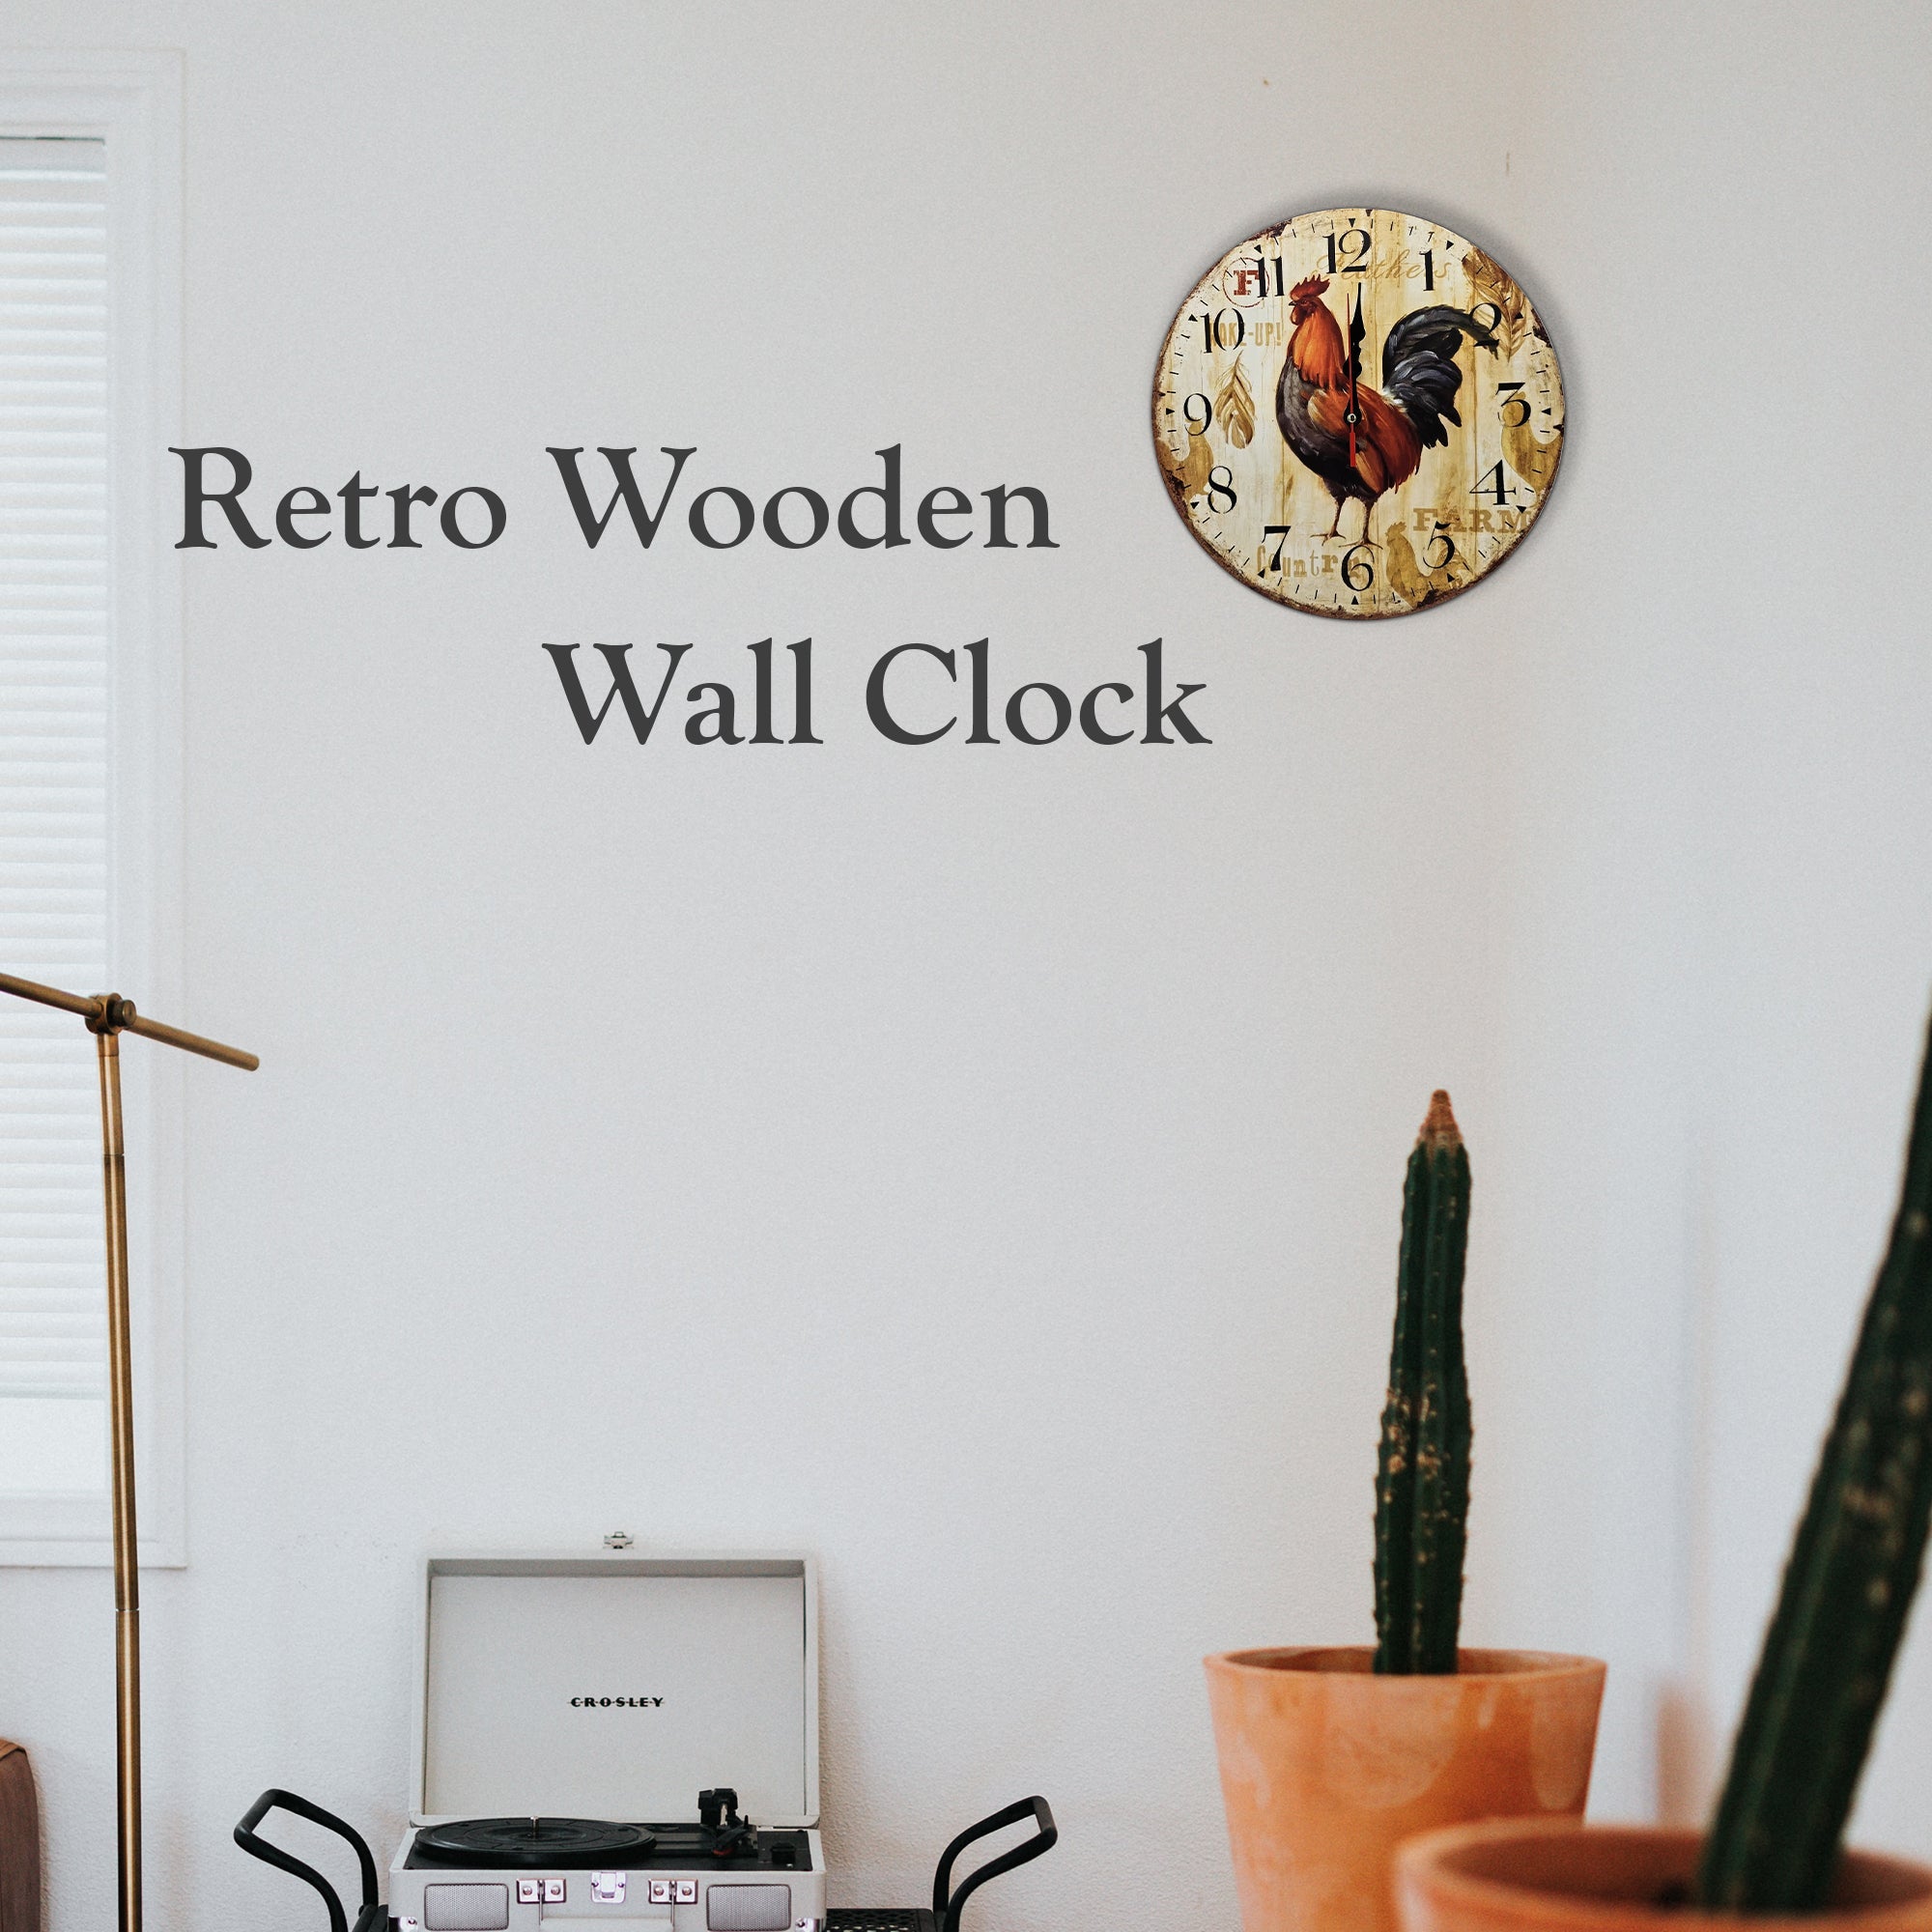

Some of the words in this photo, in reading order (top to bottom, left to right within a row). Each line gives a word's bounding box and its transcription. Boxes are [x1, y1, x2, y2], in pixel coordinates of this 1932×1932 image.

[1309, 248, 1452, 280] Feathes
[1323, 229, 1372, 273] 12
[1420, 248, 1435, 291] 1
[1254, 254, 1284, 298] 11
[1200, 308, 1244, 354] 10
[1468, 302, 1500, 347] 2
[1183, 393, 1212, 437] 9
[1495, 383, 1530, 427] 3
[1208, 466, 1237, 514] 8
[1469, 460, 1516, 505] 4
[1264, 526, 1291, 571] 7
[1341, 545, 1374, 590] 6
[1423, 523, 1455, 569] 5
[570, 1696, 664, 1708] CROSLEY
